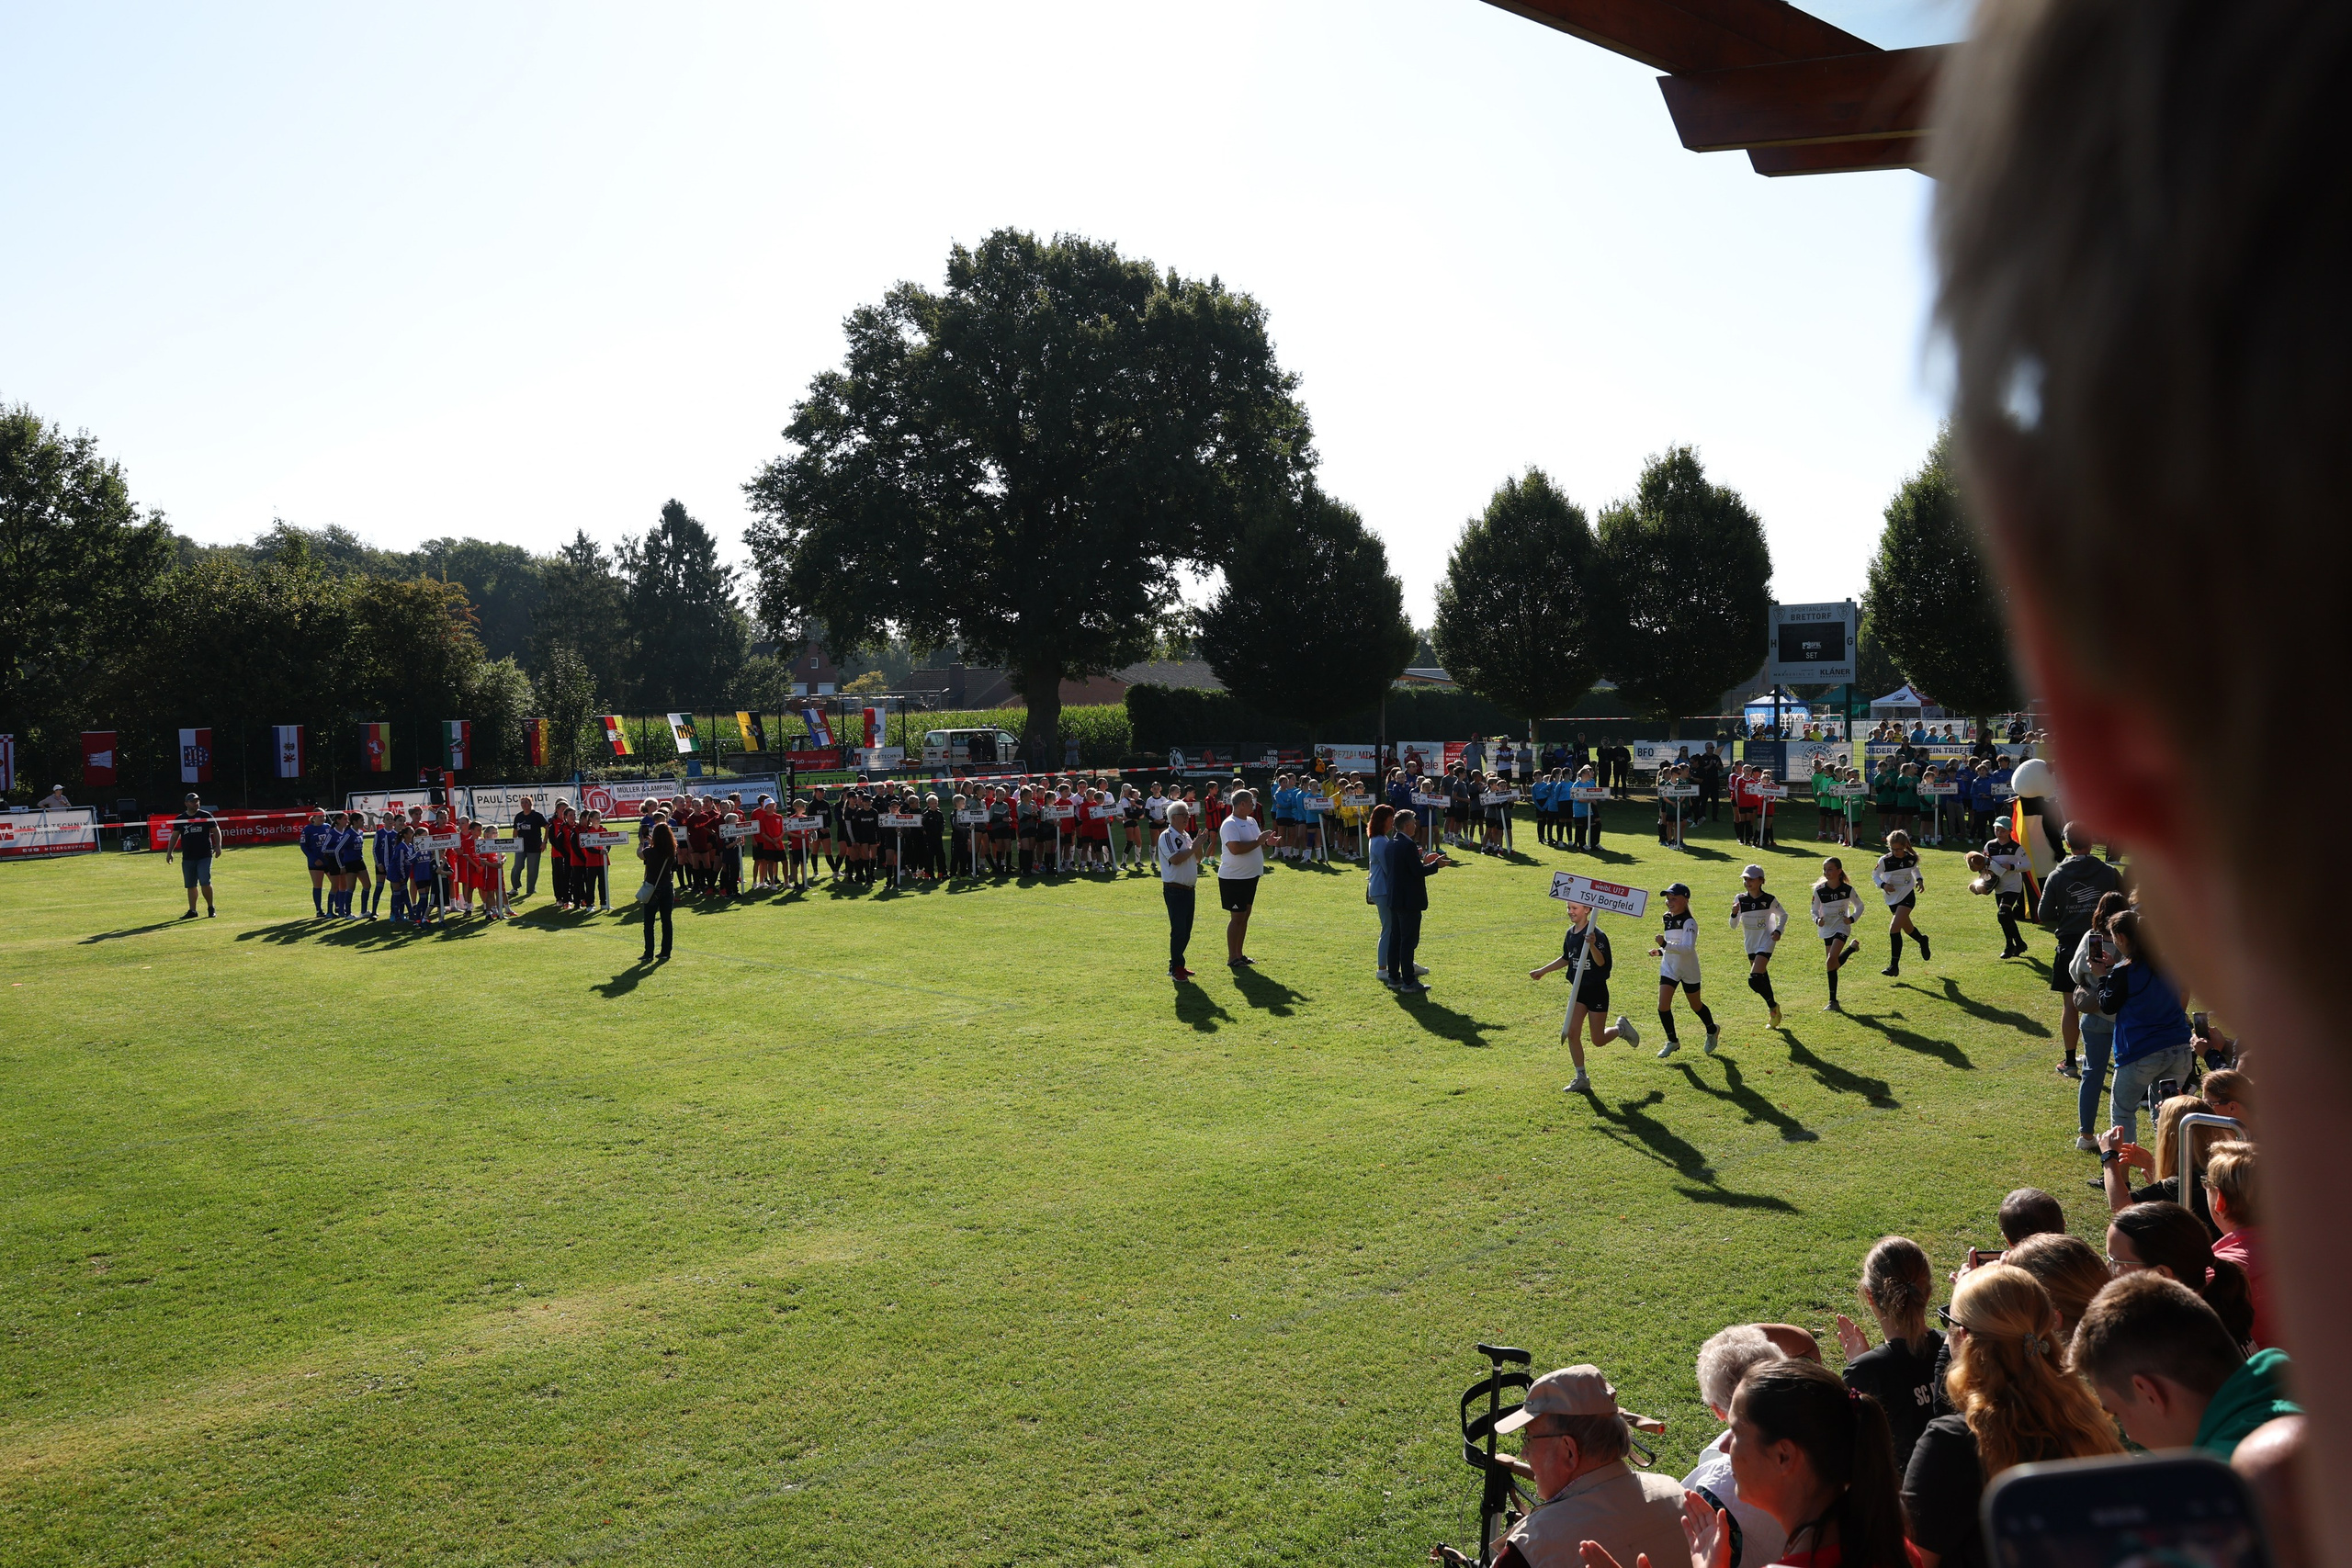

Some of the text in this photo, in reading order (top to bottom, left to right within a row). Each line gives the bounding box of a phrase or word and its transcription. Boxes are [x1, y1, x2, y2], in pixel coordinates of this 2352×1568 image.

[1791, 613, 1832, 621] BRETTORF
[1770, 639, 1777, 649] H
[1847, 637, 1853, 646] G
[1805, 651, 1818, 660] SET
[1637, 748, 1654, 757] BFO
[1805, 745, 1833, 759] EINEMANN
[616, 785, 640, 794] MÜLLER
[647, 784, 673, 792] LAMPING
[713, 787, 722, 795] die
[747, 785, 775, 794] westring
[477, 795, 503, 804] PAUL
[51, 820, 89, 829] TECHNIK
[221, 826, 254, 837] meine
[1595, 882, 1625, 896] weibl. U12
[1580, 890, 1597, 902] TSV
[1598, 895, 1634, 911] Borgfeld
[1829, 893, 1838, 901] 10
[1751, 902, 1756, 910] 9
[1667, 920, 1672, 929] 5
[1913, 1384, 1930, 1406] SC
